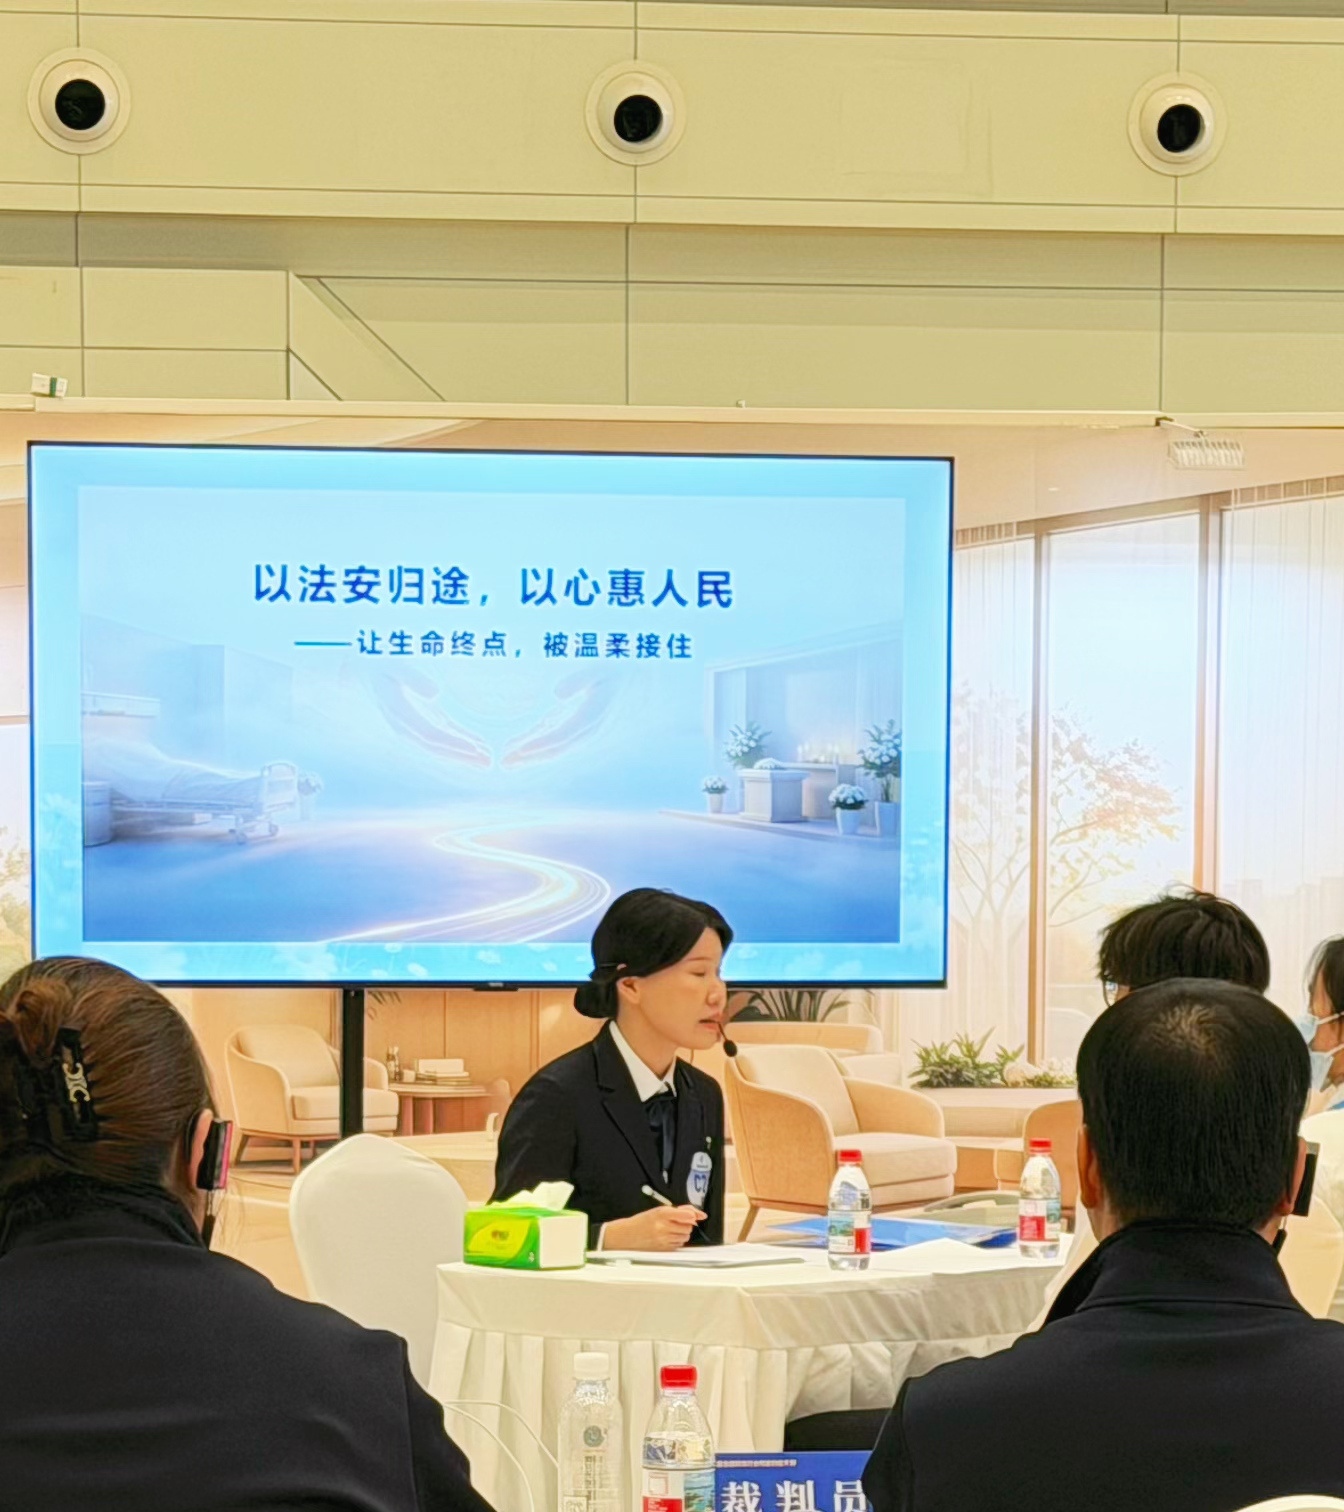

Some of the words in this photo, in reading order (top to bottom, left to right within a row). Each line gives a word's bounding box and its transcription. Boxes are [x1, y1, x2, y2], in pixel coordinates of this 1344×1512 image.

[254, 563, 733, 609] 以法安归途，以心惠人民
